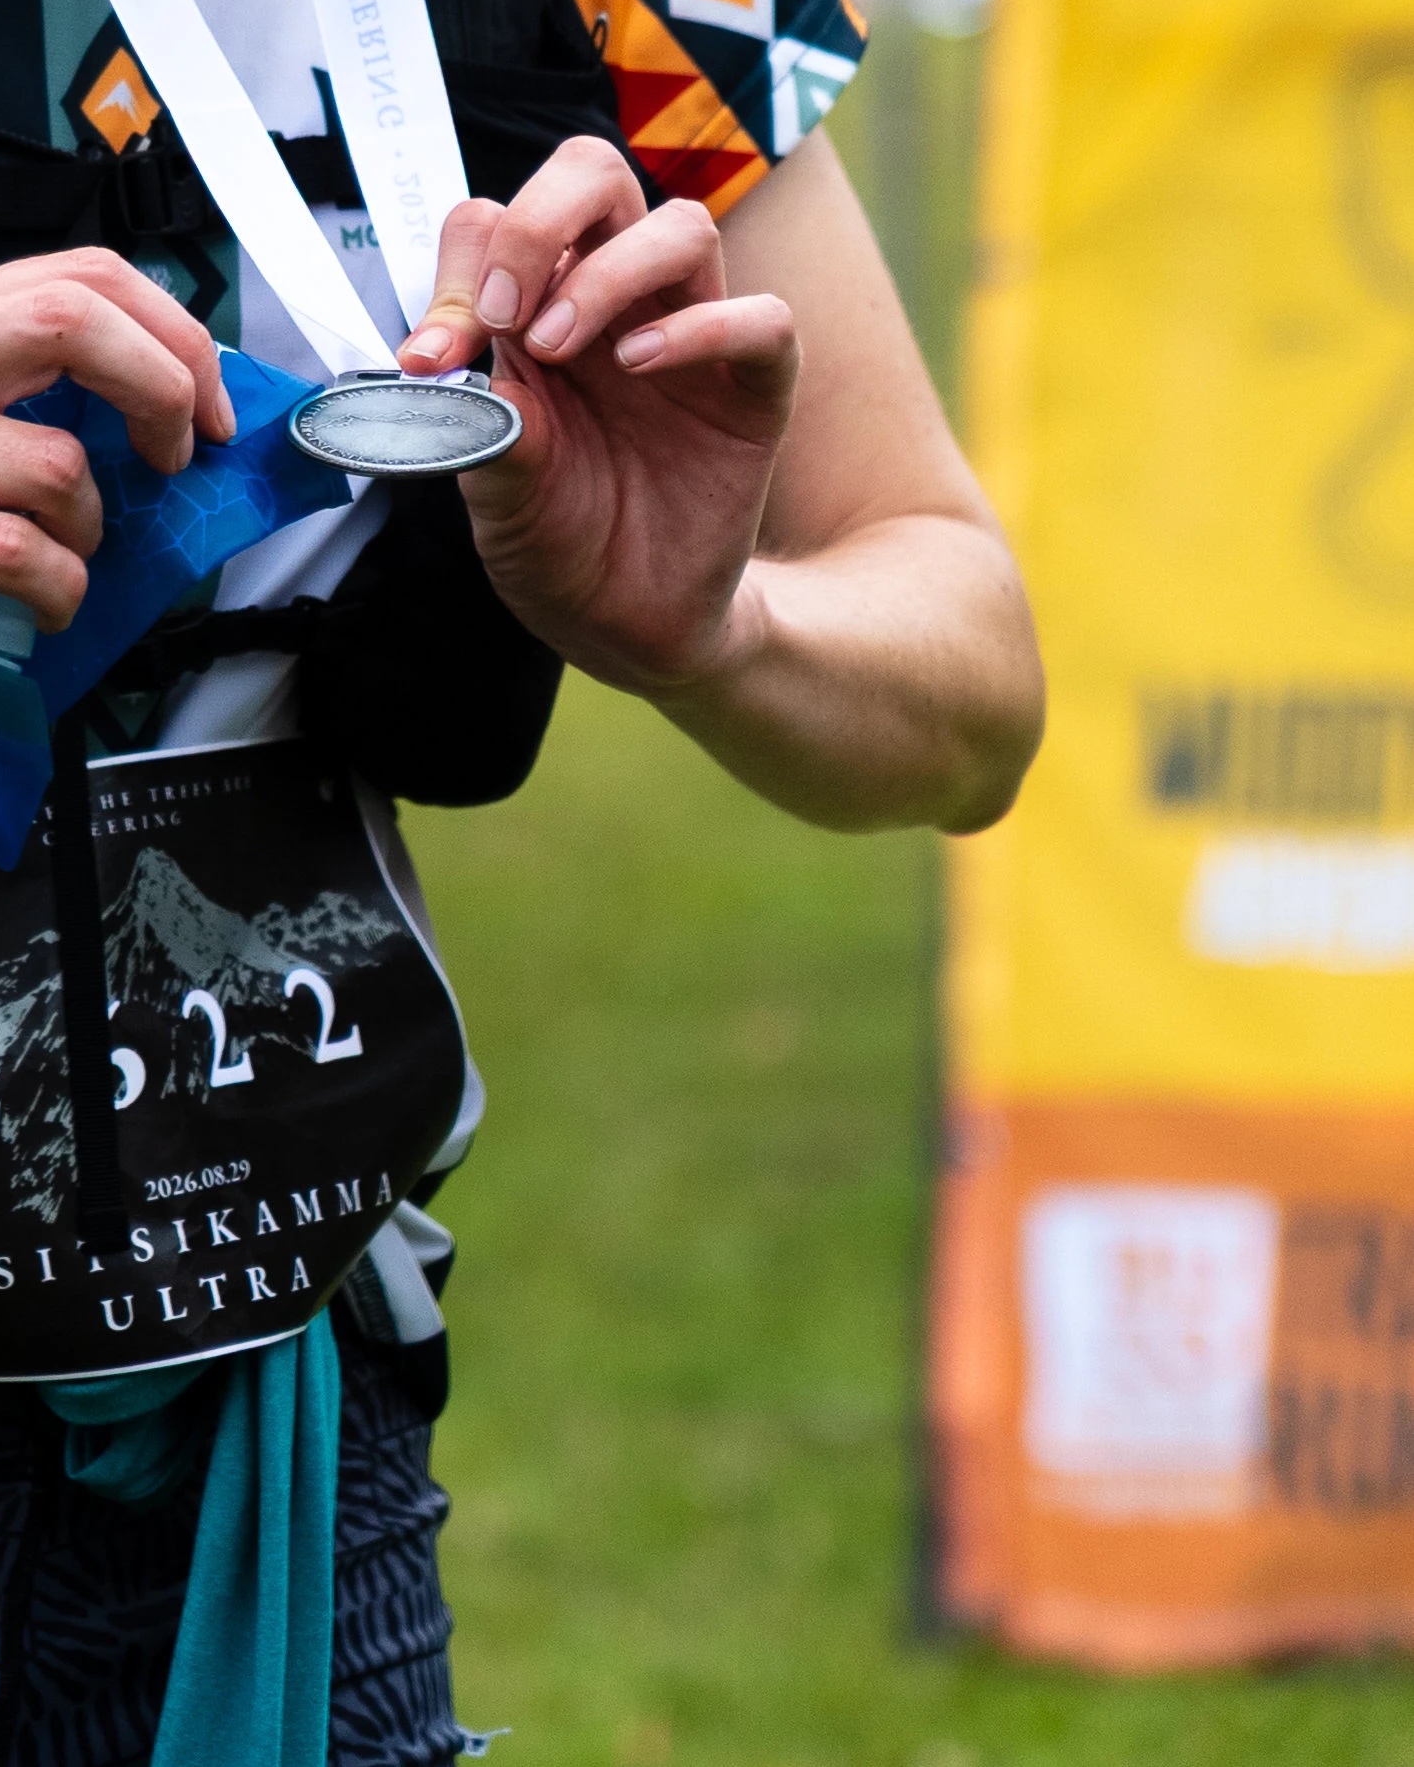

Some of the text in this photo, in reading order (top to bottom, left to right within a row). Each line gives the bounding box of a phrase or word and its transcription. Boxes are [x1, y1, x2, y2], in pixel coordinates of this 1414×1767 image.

[98, 790, 133, 811] HE
[42, 810, 183, 847] CEERING
[145, 1160, 251, 1202] 2026.08.29
[101, 1255, 313, 1332] ULTRA
